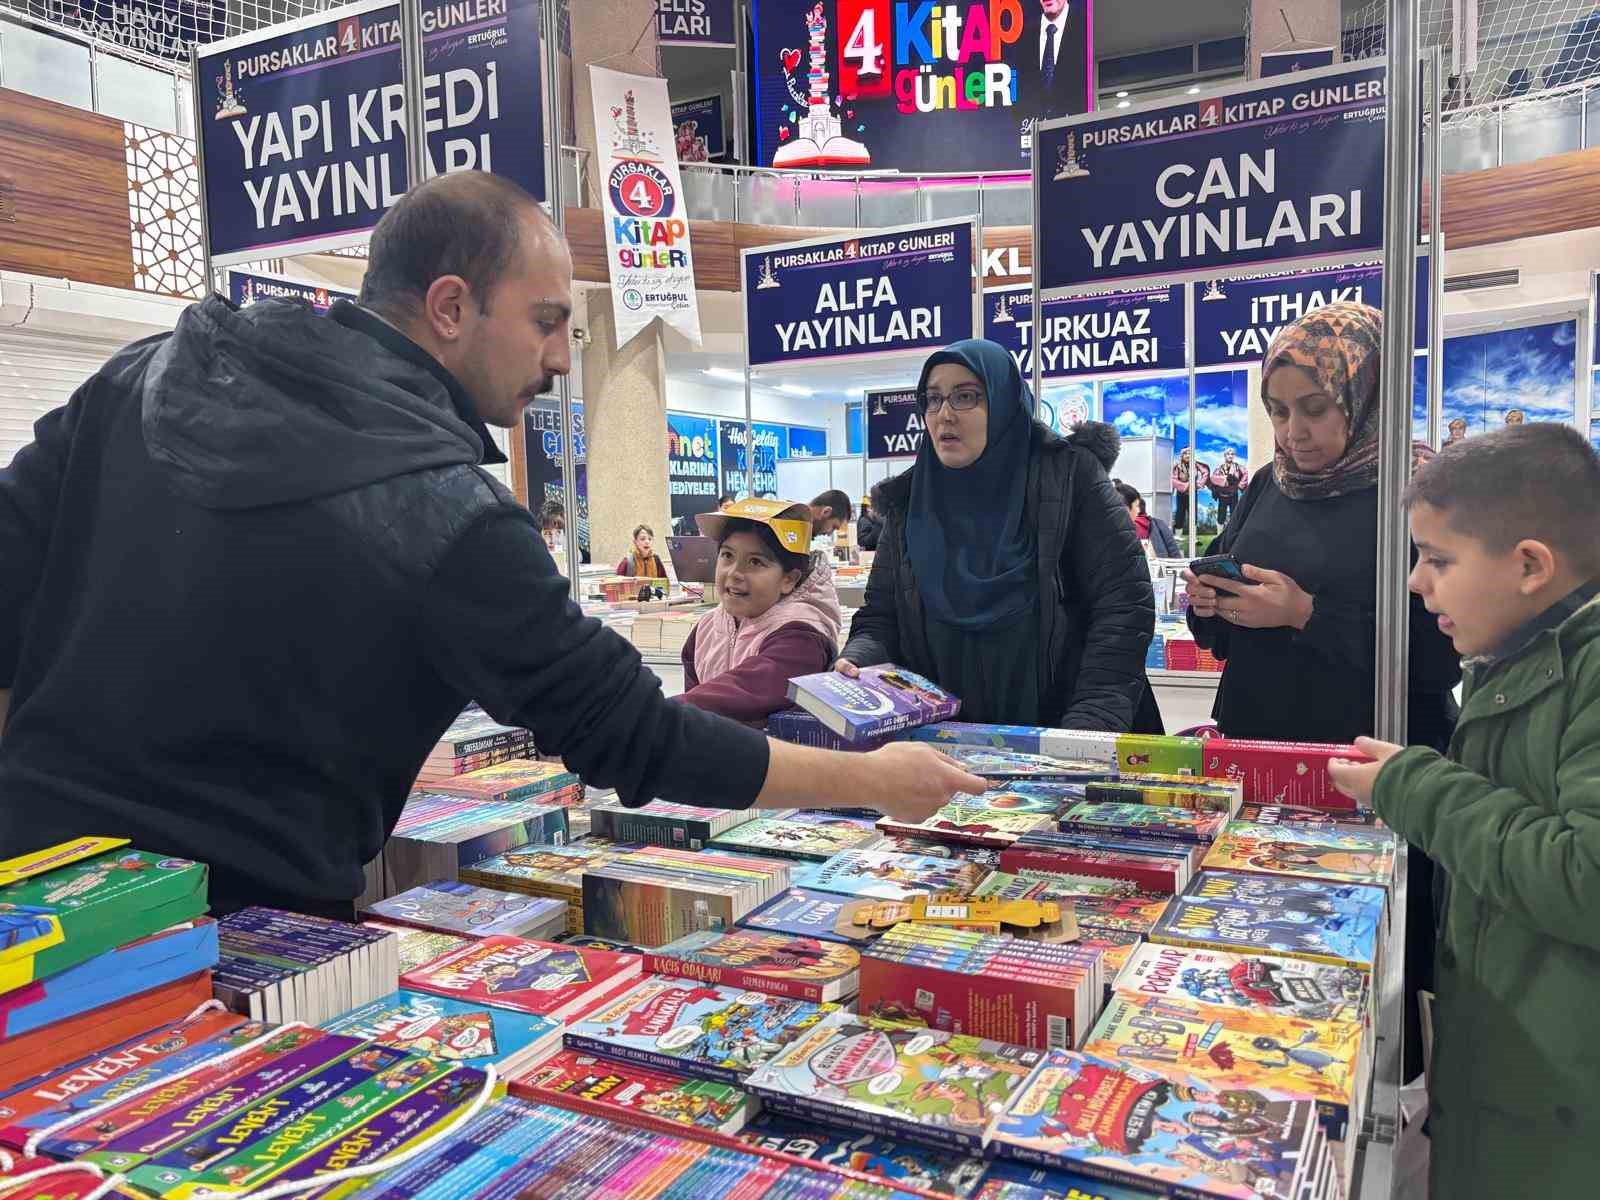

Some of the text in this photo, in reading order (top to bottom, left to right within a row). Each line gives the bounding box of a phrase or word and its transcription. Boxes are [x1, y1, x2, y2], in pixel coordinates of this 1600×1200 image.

[237, 36, 338, 79] PURSAKLAR
[340, 25, 360, 52] 4
[843, 8, 883, 76] 4
[232, 99, 333, 170] YAPI
[1081, 114, 1198, 149] PURSAKLAR
[1201, 105, 1220, 127] 4
[610, 162, 673, 196] PURSAKLAR
[629, 180, 653, 209] 4
[1155, 148, 1276, 209] CAN
[1080, 190, 1361, 268] YAYINLARI
[774, 249, 844, 269] PURSAKLAR
[844, 243, 857, 259] 4
[814, 275, 898, 314] ALFA
[774, 305, 941, 353] YAYINLARI
[34, 1042, 160, 1101] LEVENT
[129, 1076, 200, 1116] LEVENT
[172, 1086, 246, 1128] LEVENT
[216, 1098, 290, 1145] LEVENT
[253, 1112, 327, 1161] LEVENT
